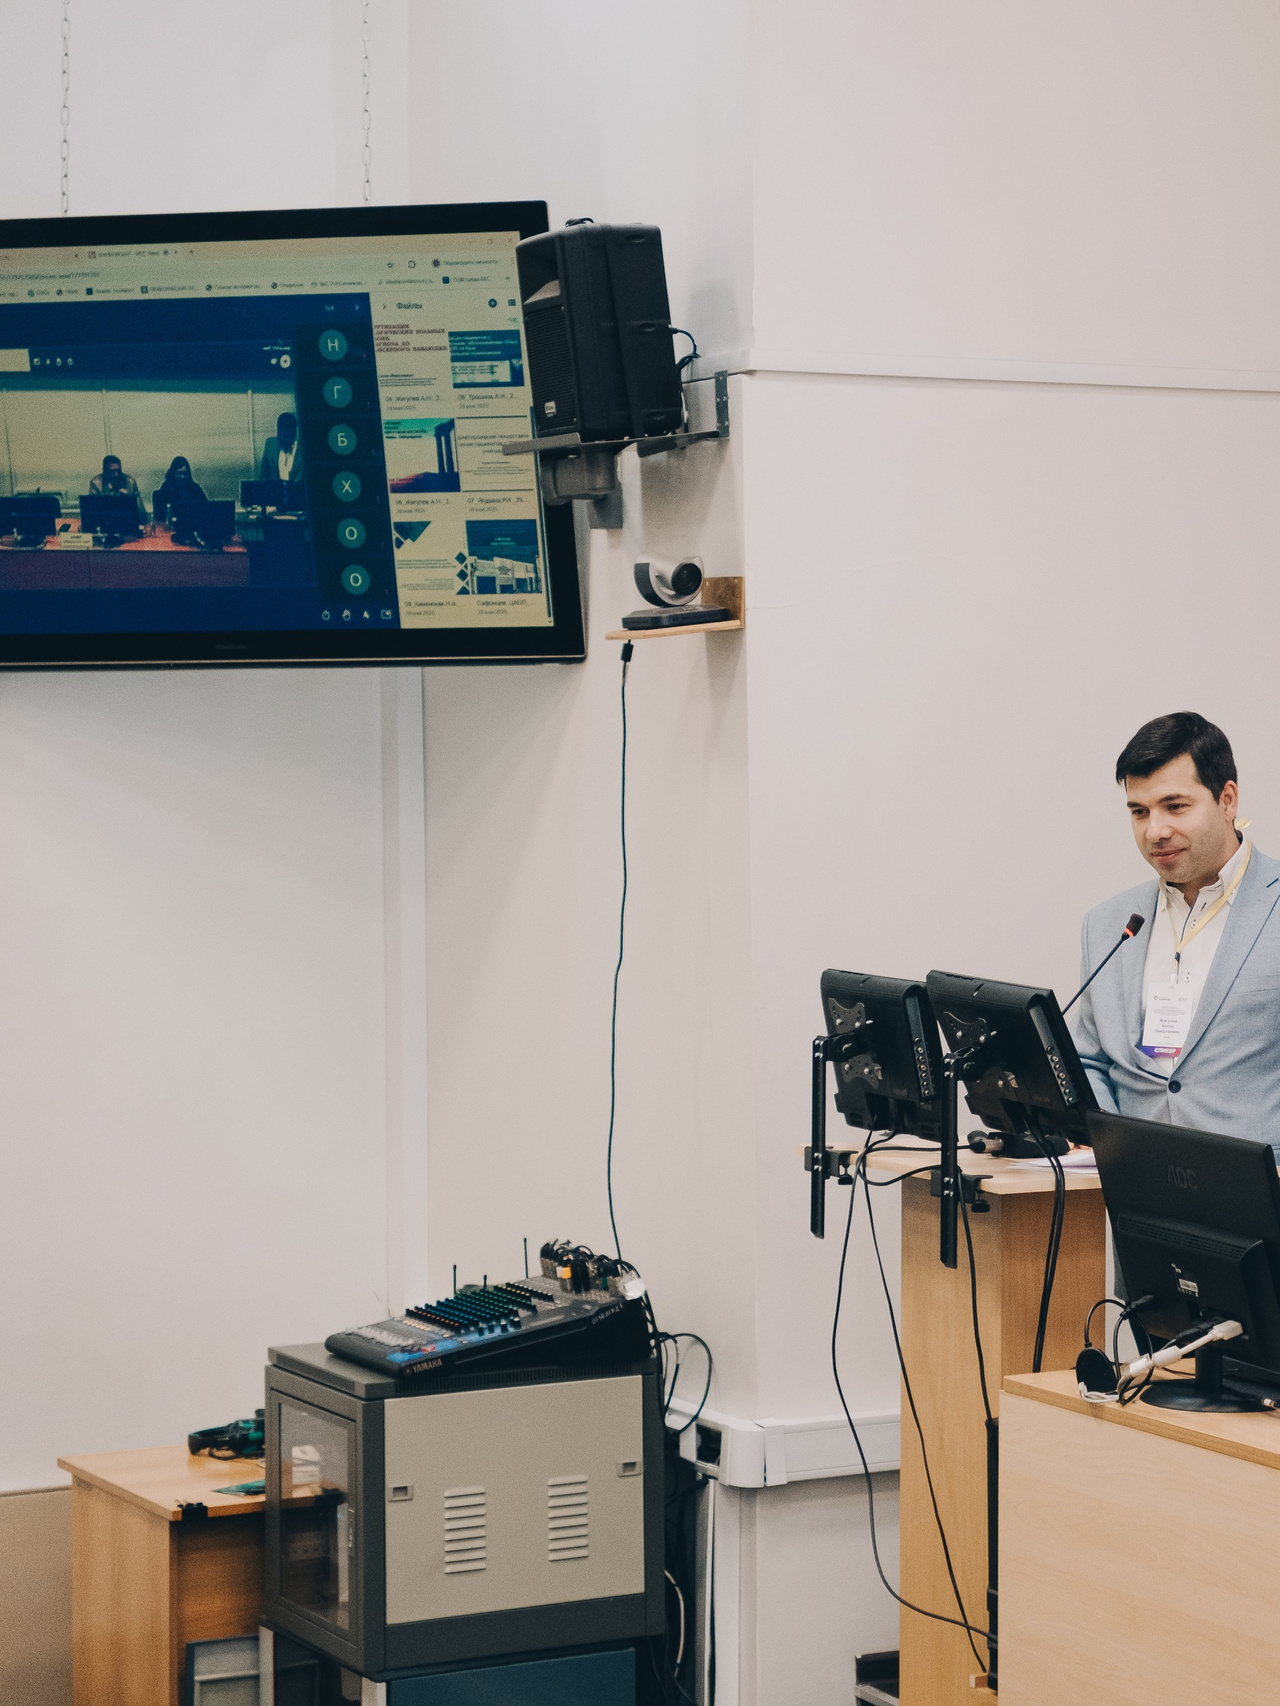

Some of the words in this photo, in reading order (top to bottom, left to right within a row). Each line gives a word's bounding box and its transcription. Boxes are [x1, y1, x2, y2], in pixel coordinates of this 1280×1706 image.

[396, 302, 423, 310] Файлы
[327, 338, 339, 352] Н
[333, 385, 342, 400] Г
[337, 433, 348, 447] Б
[342, 480, 352, 493] Х
[345, 526, 357, 540] О
[349, 572, 362, 587] О
[412, 1358, 443, 1373] YAMAHA
